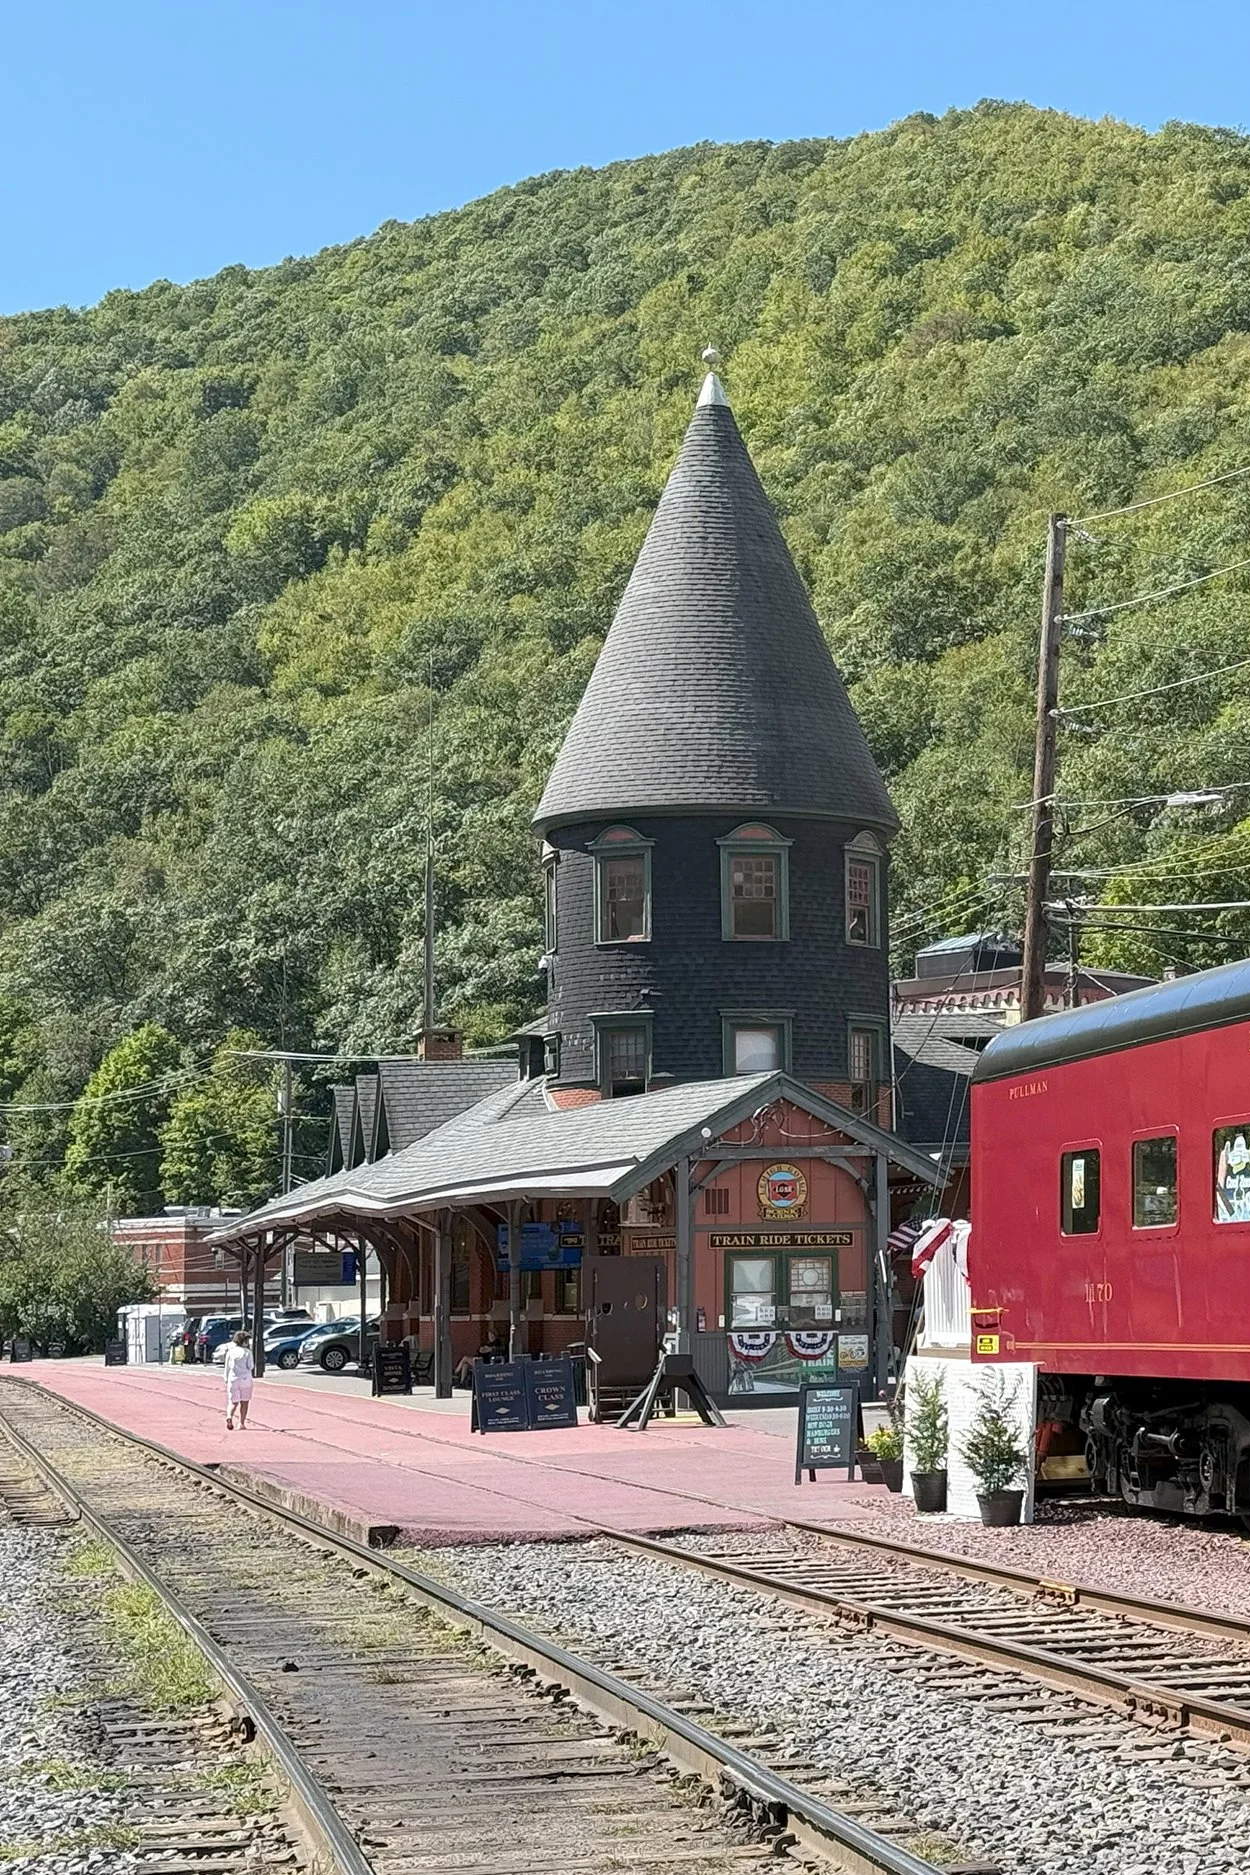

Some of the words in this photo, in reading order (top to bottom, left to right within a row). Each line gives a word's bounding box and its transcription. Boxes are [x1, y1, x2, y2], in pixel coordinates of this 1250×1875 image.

[1008, 1080, 1049, 1100] PULLMAN
[712, 1235, 756, 1246] TRAIN
[759, 1234, 791, 1245] RIDE
[794, 1233, 851, 1245] TICKETS
[534, 1385, 566, 1394] CROWN
[537, 1393, 565, 1402] CLASS
